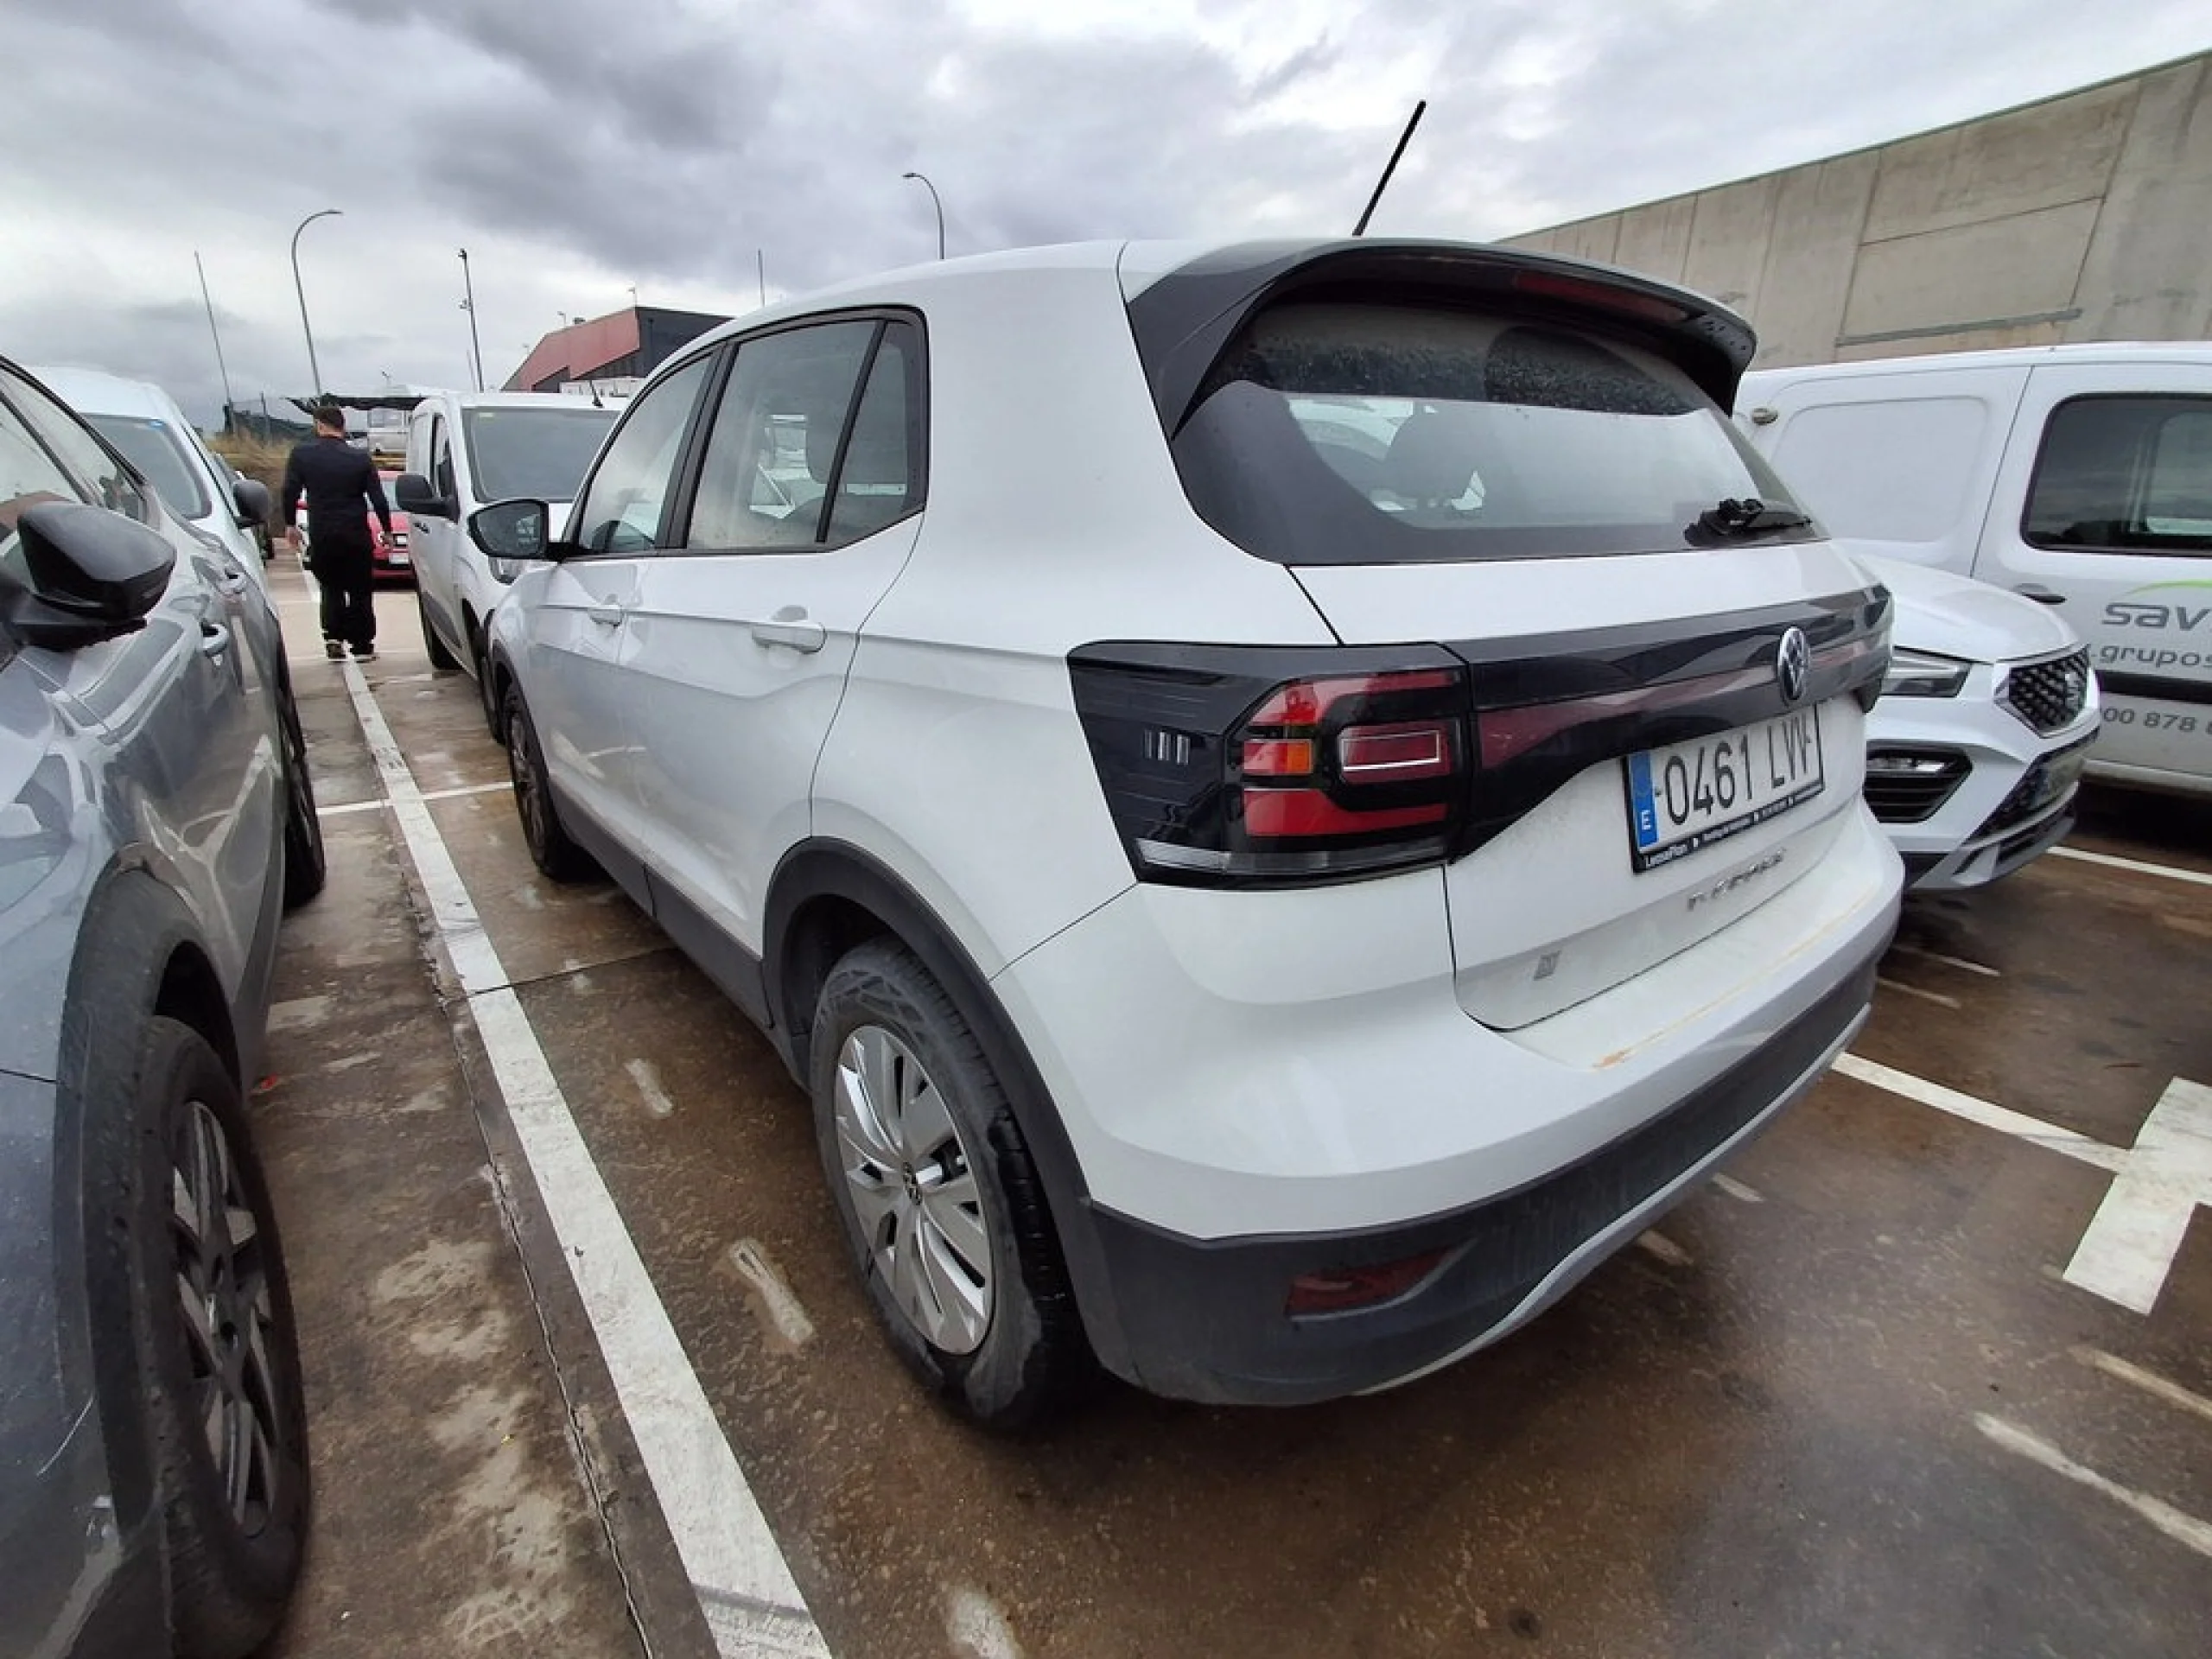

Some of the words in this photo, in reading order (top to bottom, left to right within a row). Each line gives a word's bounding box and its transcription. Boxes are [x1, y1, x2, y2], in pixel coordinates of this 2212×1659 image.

[2143, 712, 2197, 732] 878
[1664, 732, 1753, 825] 0461
[1641, 809, 1652, 831] E
